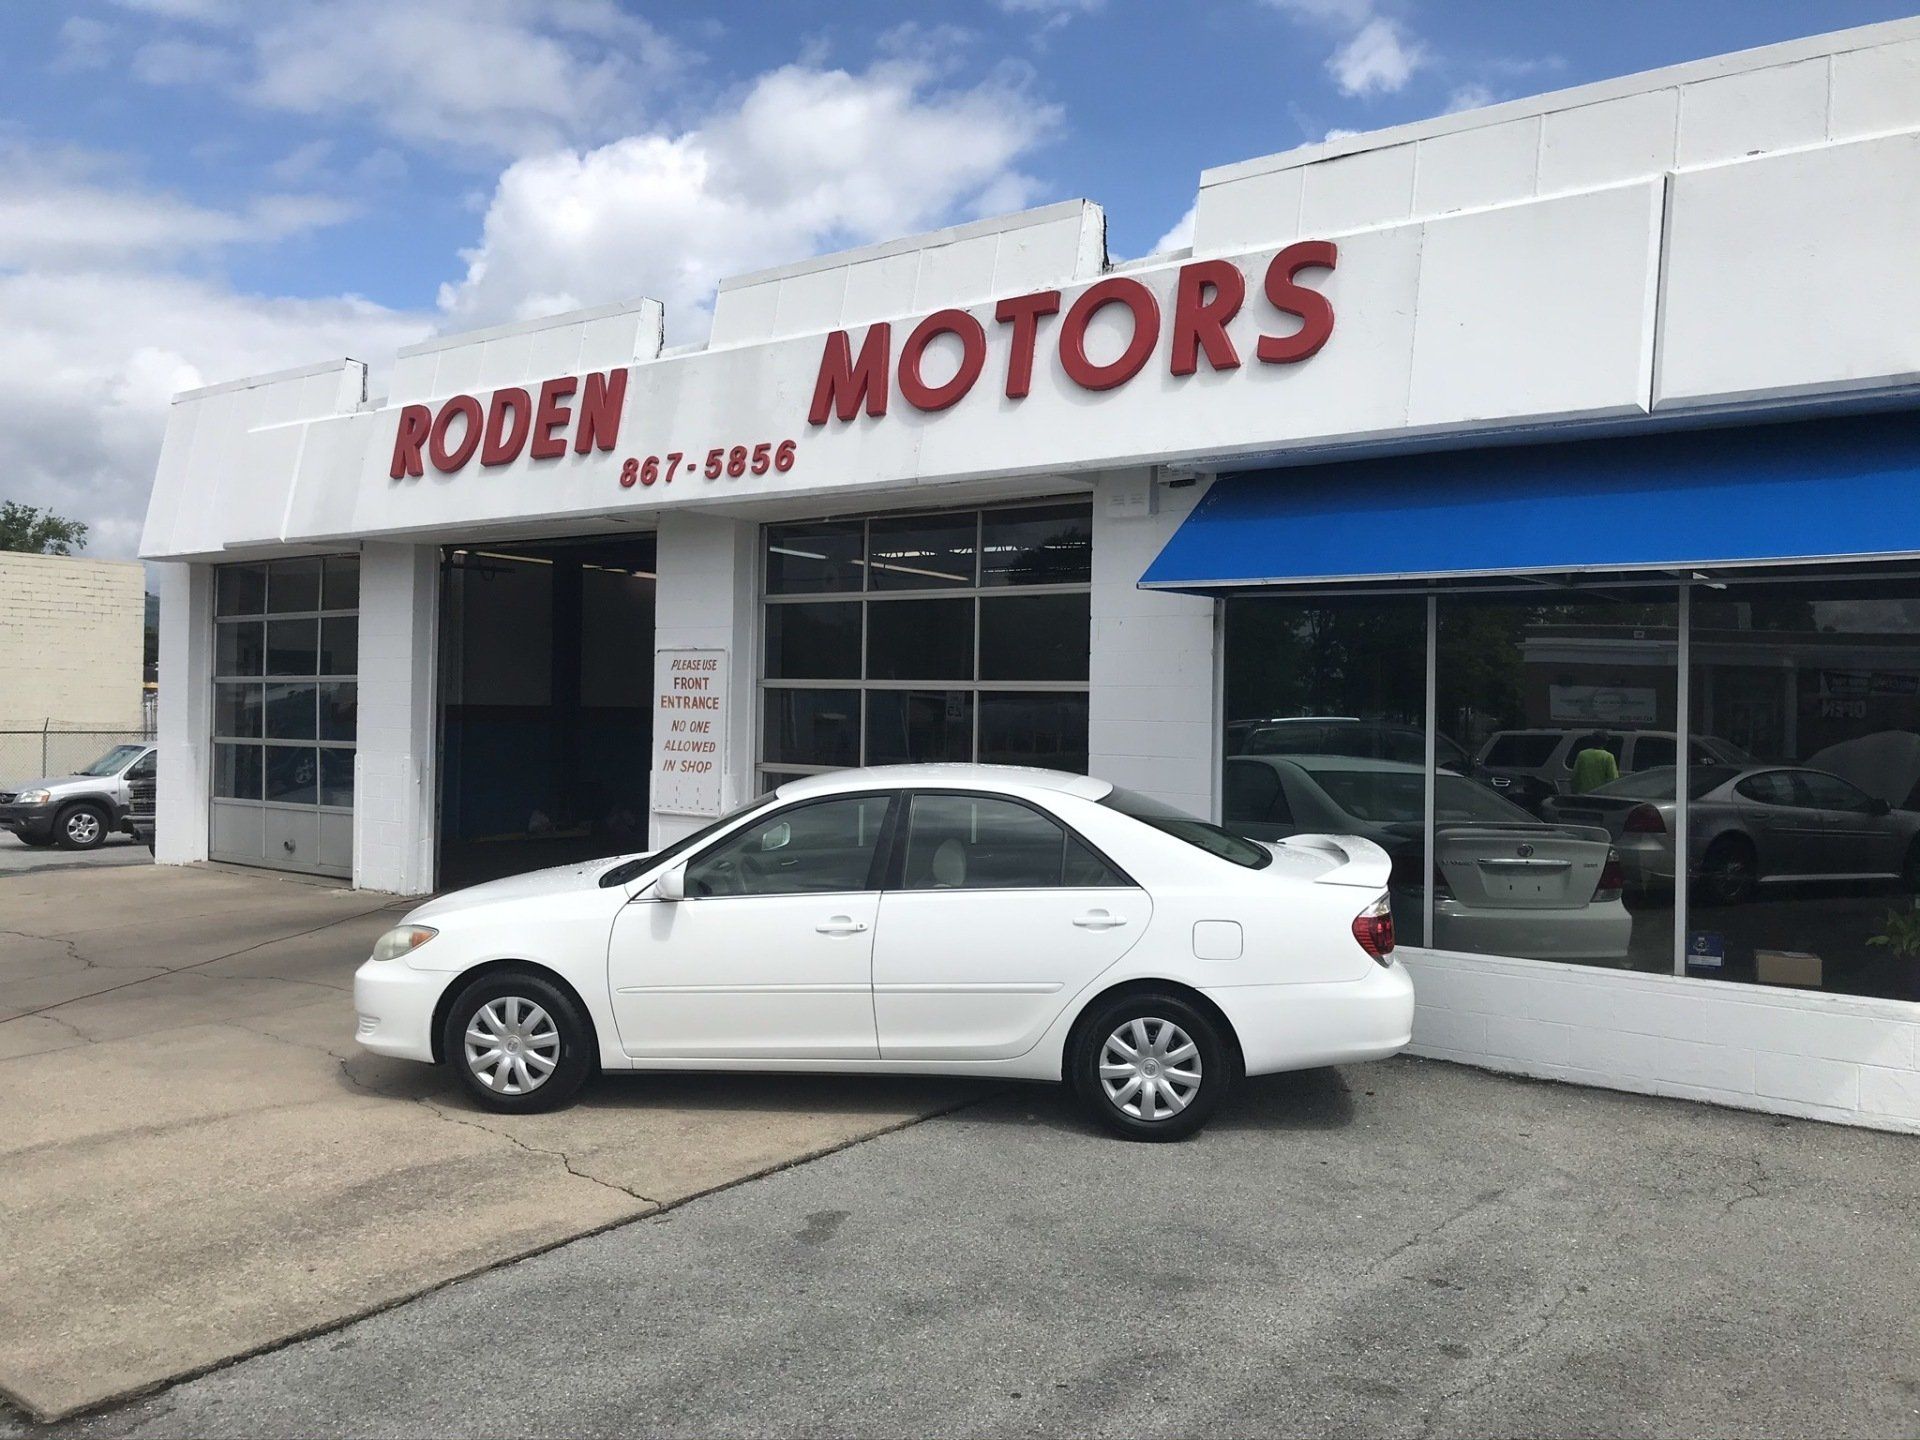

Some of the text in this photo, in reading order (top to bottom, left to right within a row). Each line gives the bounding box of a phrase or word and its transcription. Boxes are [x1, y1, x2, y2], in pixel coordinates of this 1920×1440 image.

[389, 240, 1338, 479] RODEN MOTORS
[620, 439, 796, 488] 867-5856
[671, 659, 717, 671] PLEASE USE
[674, 677, 710, 690] FRONT
[661, 695, 719, 710] ENTRANCE
[671, 720, 711, 734] NO ONE
[664, 740, 716, 752] ALLOWED
[663, 759, 712, 773] IN SHOP
